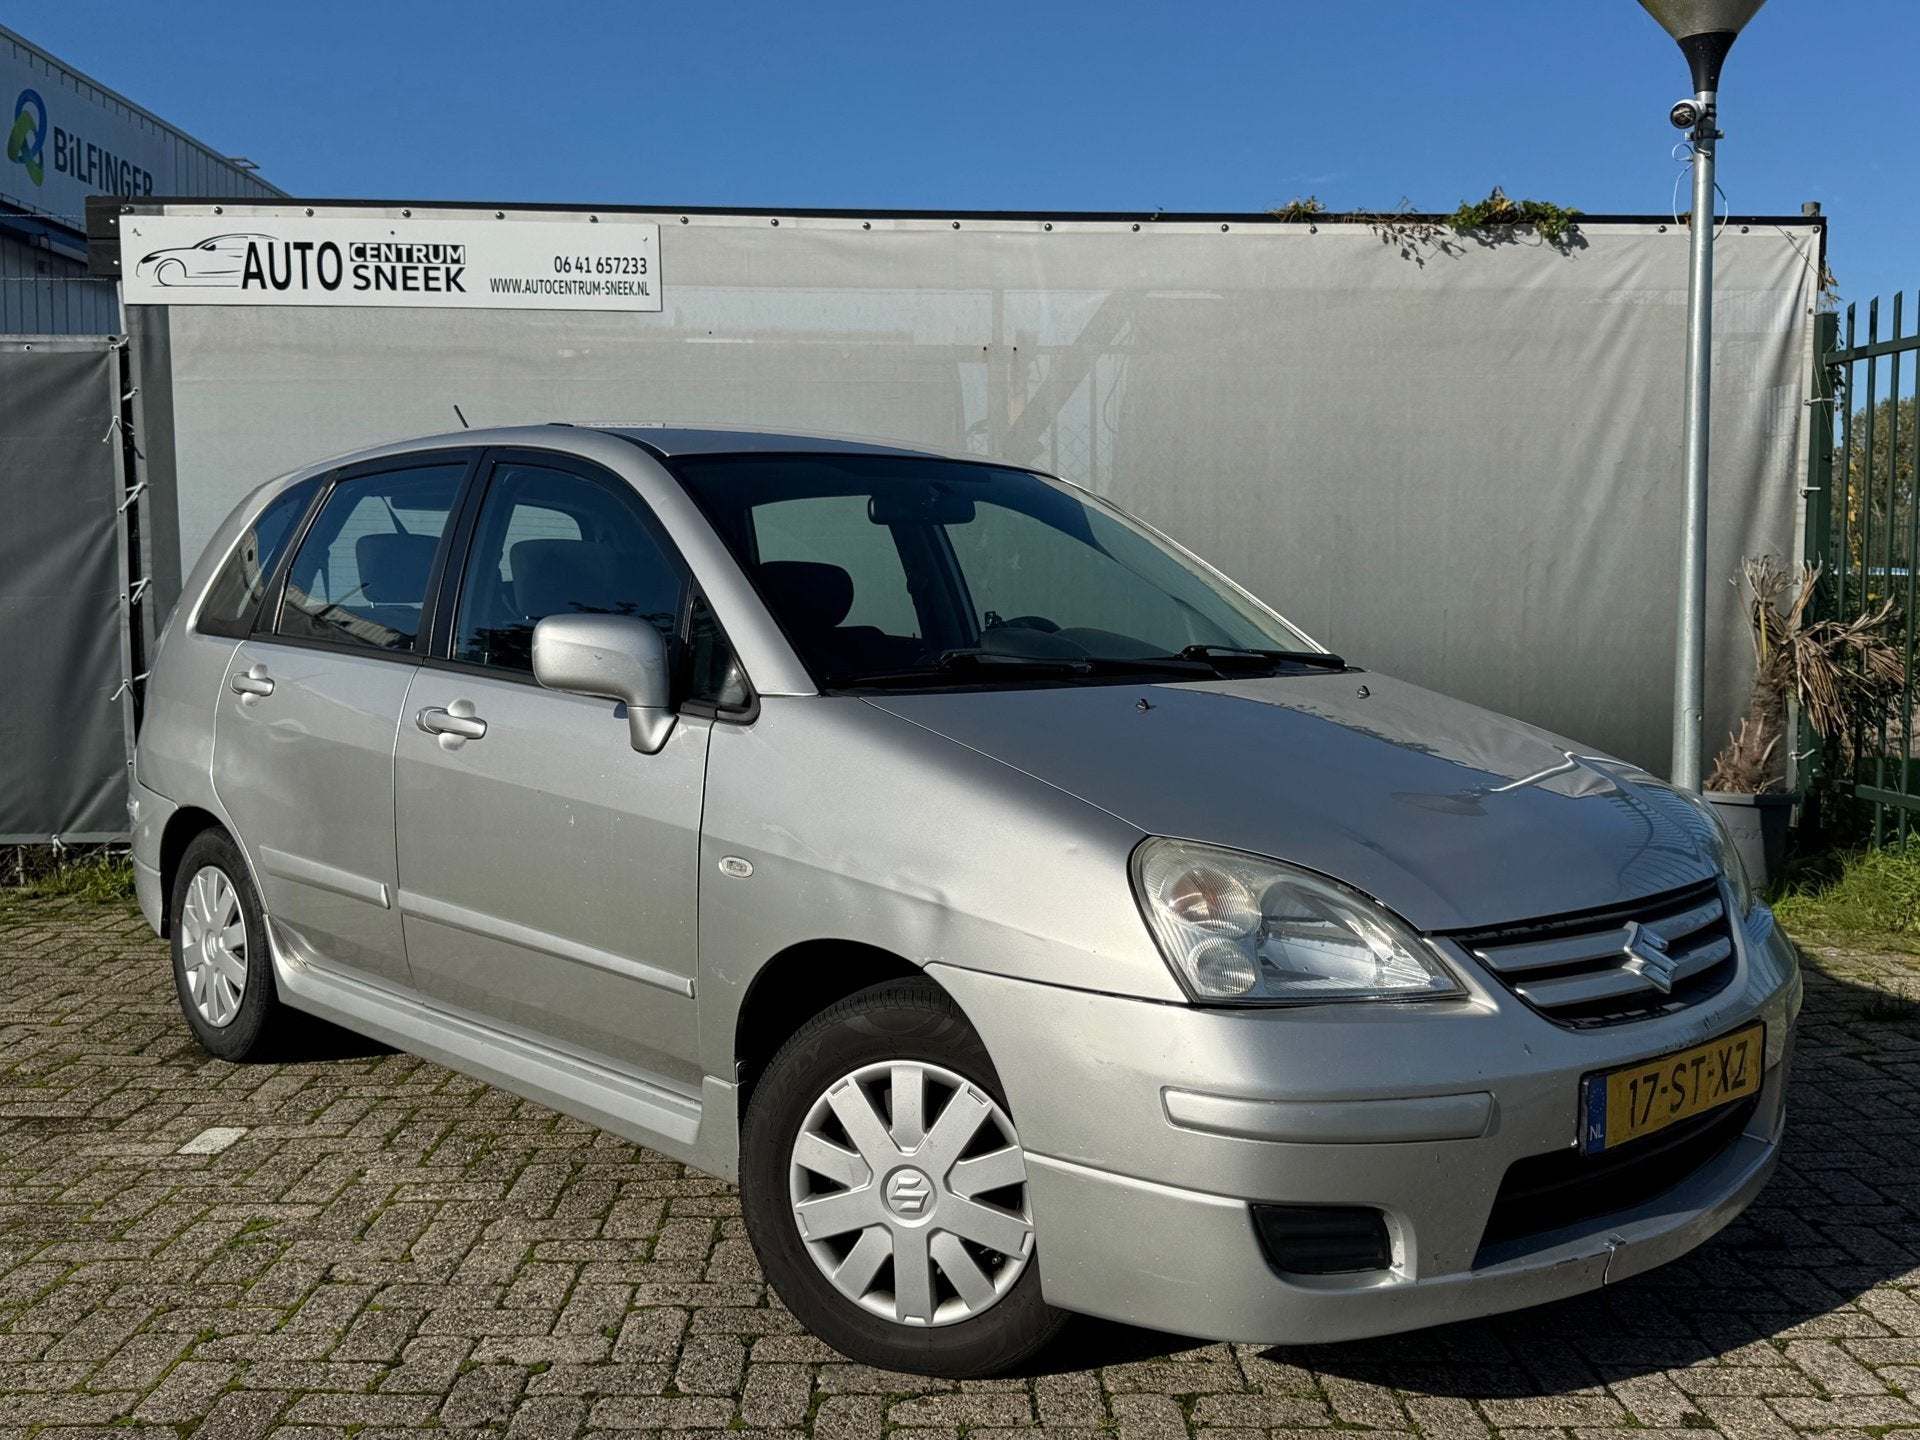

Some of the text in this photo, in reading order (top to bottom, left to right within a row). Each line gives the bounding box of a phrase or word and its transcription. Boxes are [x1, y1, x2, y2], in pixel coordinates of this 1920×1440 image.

[350, 243, 465, 264] CENTRUM
[242, 241, 343, 291] AUTO
[554, 256, 648, 275] 06 41 657233
[353, 265, 467, 292] SNEEK
[490, 278, 650, 296] WWW.AUTOCENTRUM-SNEEK.NL
[1629, 1040, 1748, 1129] 17-ST-XZ
[1590, 1124, 1604, 1141] NL
